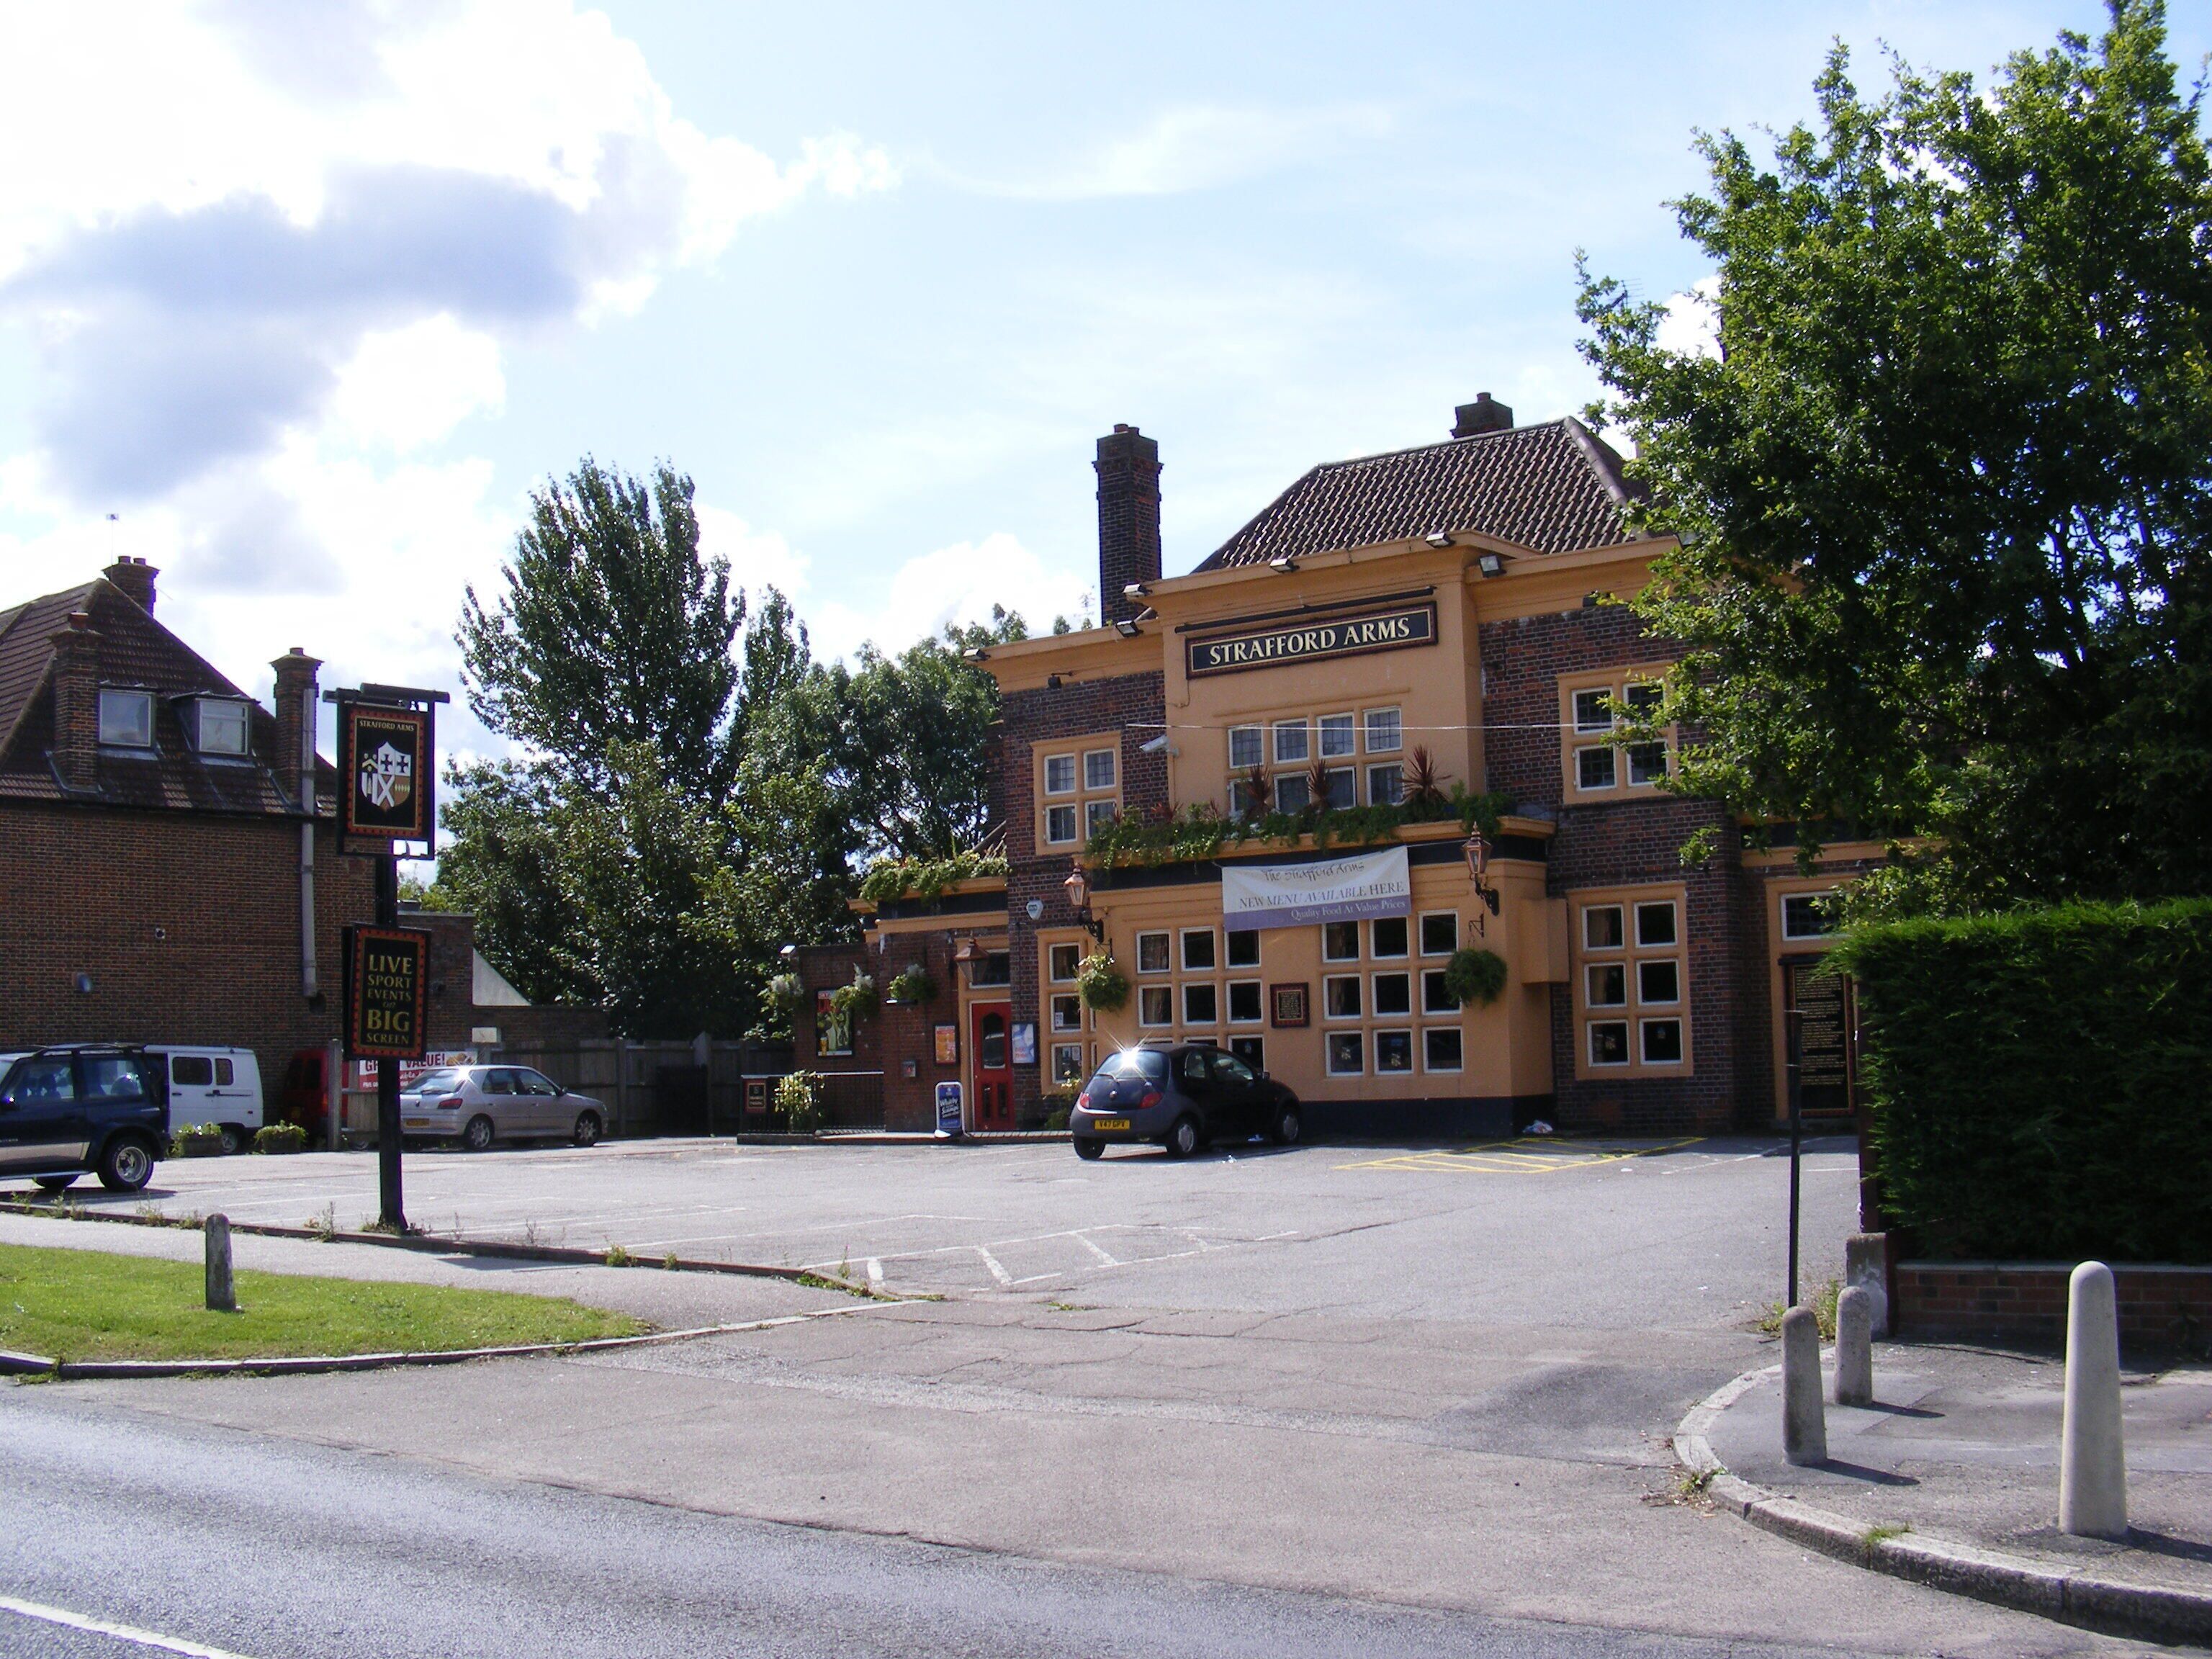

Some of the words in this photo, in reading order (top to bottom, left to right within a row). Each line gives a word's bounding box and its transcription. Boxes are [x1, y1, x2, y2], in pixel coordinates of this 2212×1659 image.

[1210, 629, 1336, 665] STRAFFORD
[1344, 617, 1410, 645] ARMS
[360, 720, 395, 729] STRAFFORD
[1262, 868, 1282, 881] The
[1336, 863, 1364, 874] Arms
[1239, 896, 1264, 909] NEW
[1267, 894, 1302, 906] MENU
[1304, 886, 1367, 902] AVAILABLE
[1370, 881, 1404, 895] HERE
[1291, 909, 1320, 921] Quality
[1321, 905, 1342, 916] Food
[1344, 904, 1354, 914] At
[1355, 902, 1379, 912] Value
[1381, 899, 1406, 910] Prices
[368, 954, 412, 974] LIVE
[368, 974, 411, 989] SPORT
[368, 989, 412, 1002] EVENTS
[367, 1009, 410, 1033] BIG
[367, 1033, 409, 1044] SCREEN
